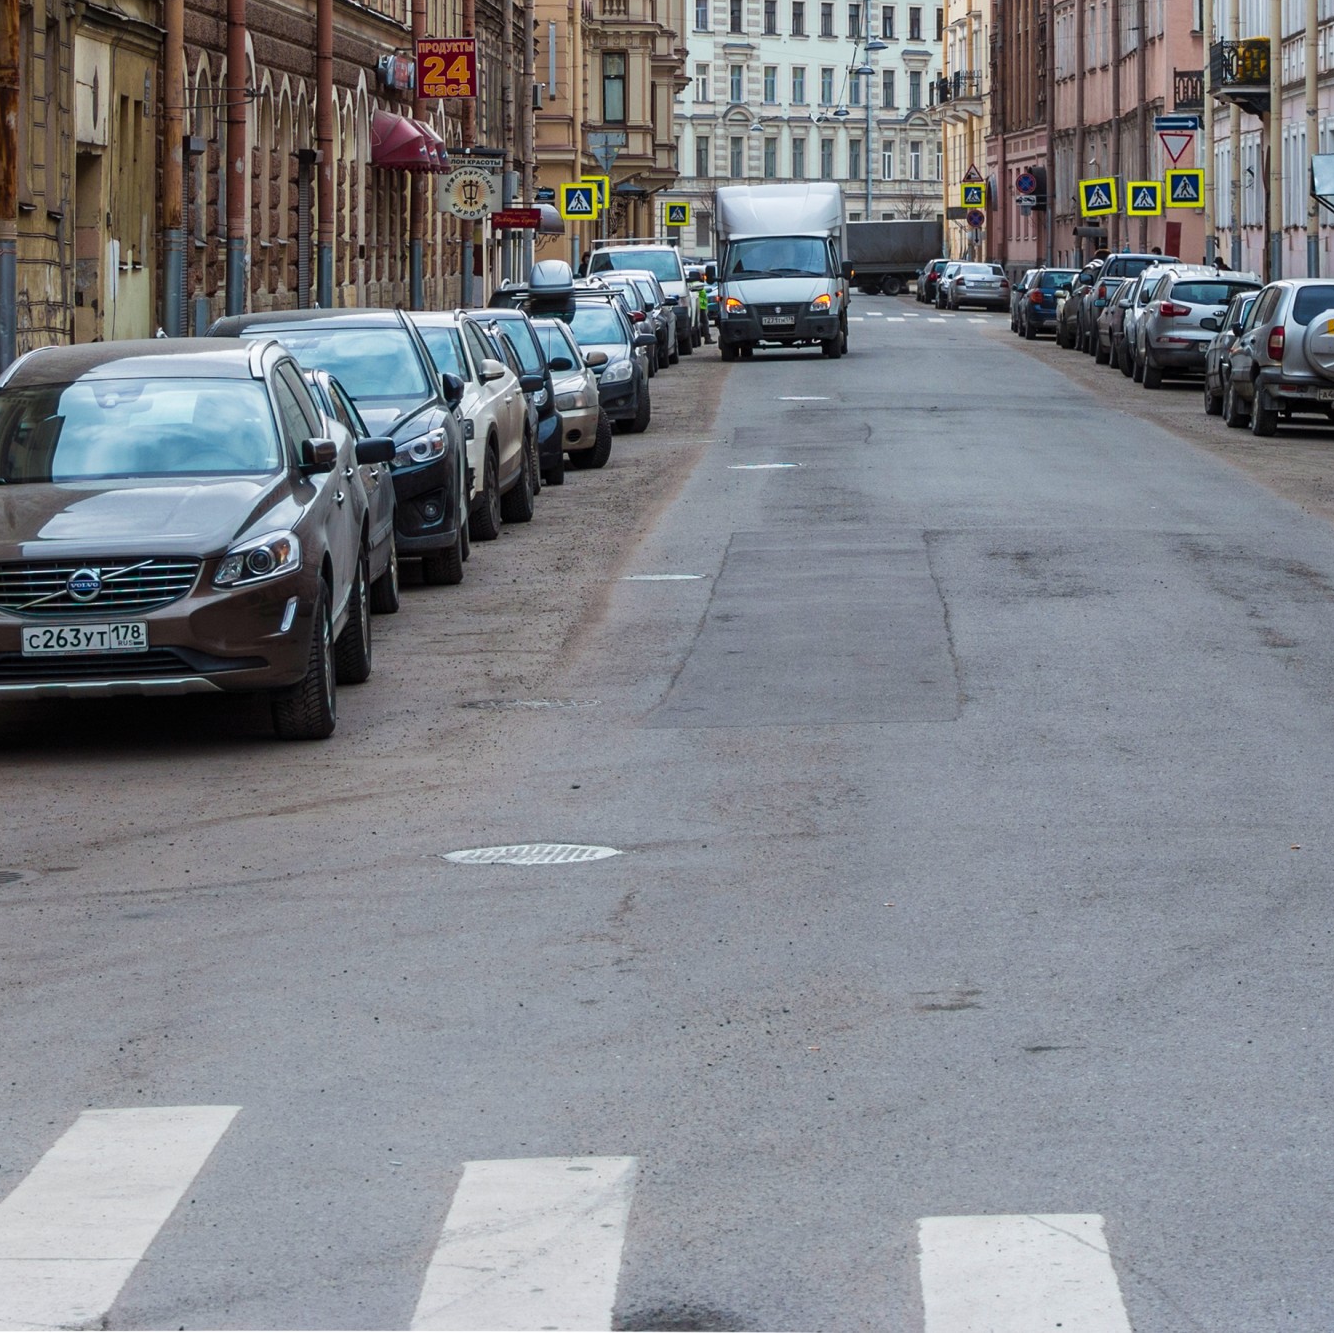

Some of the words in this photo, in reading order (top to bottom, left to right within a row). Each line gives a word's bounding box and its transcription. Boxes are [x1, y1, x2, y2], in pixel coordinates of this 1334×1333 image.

[418, 42, 474, 54] ПРОДУКТЫ
[424, 56, 470, 84] 24
[424, 84, 471, 96] часа
[111, 625, 141, 641] 178
